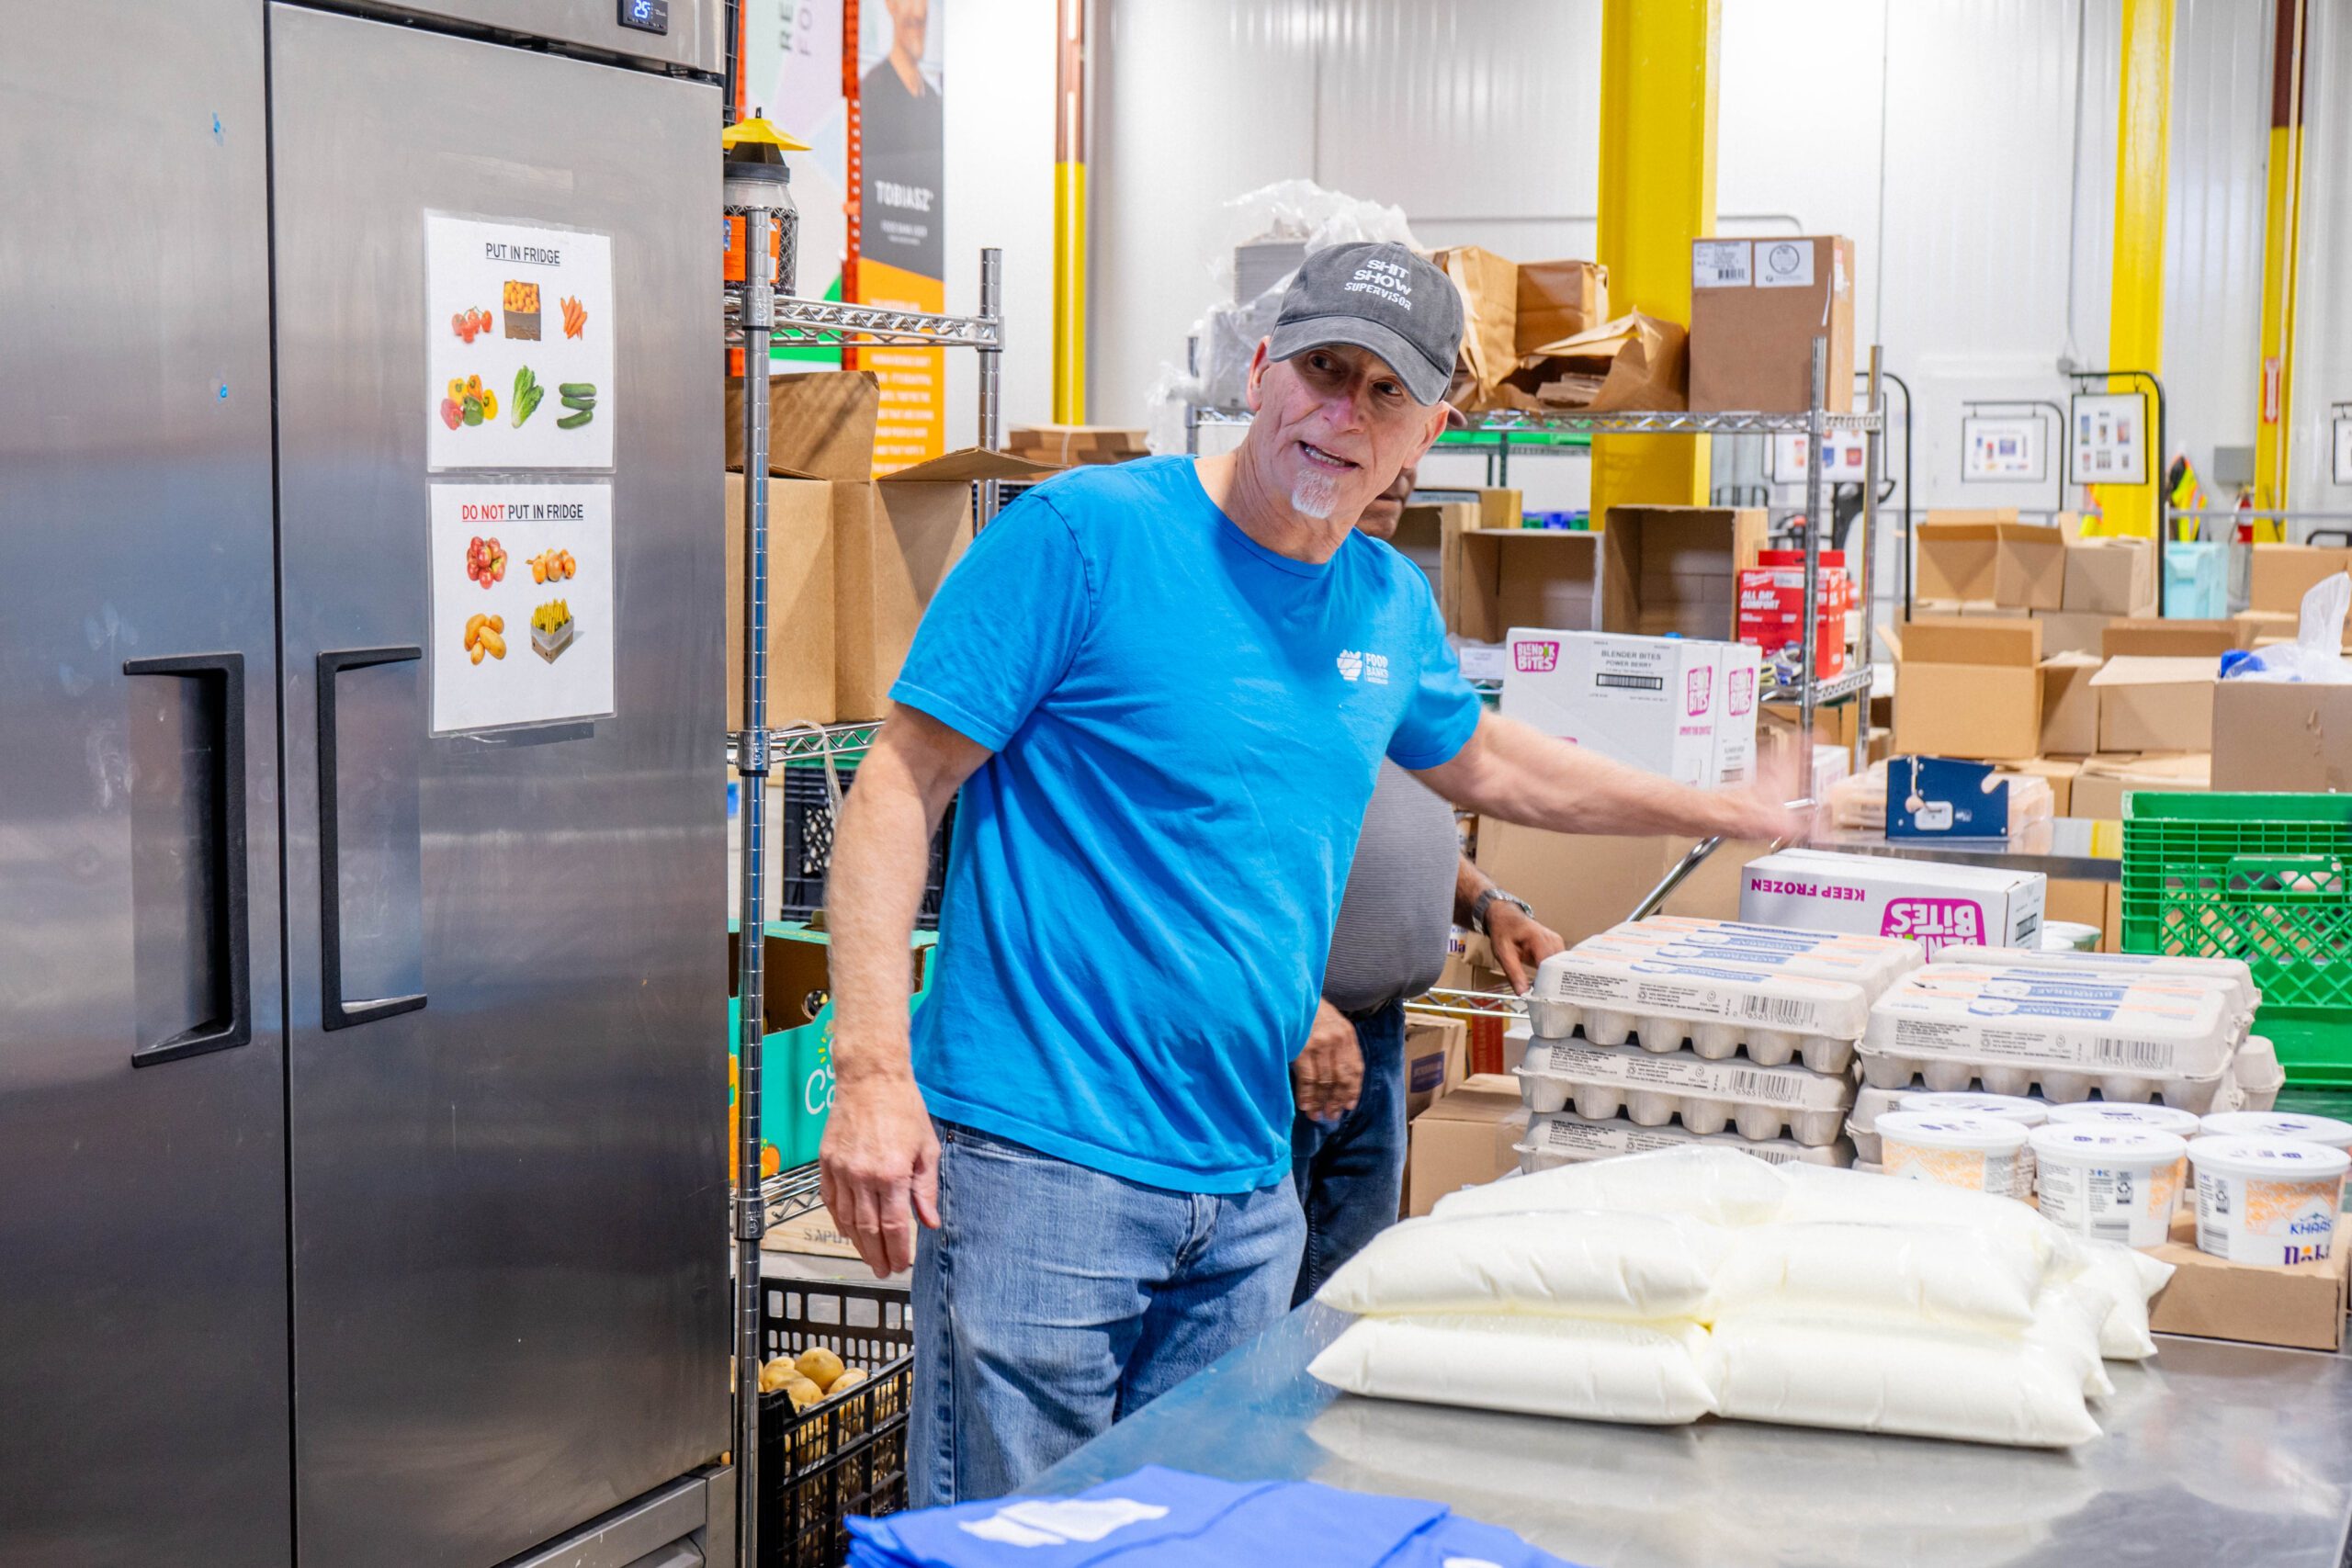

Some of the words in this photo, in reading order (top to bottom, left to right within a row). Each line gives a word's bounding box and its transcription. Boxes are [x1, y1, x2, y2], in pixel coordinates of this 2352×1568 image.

[485, 243, 507, 258] PUT
[510, 245, 521, 260] IN
[524, 246, 560, 265] FRIDGE
[1366, 259, 1409, 279] SHIT
[1352, 269, 1412, 296] SHOW
[462, 504, 478, 520] DO
[481, 504, 505, 520] NOT
[508, 504, 529, 520] PUT
[533, 504, 544, 519] IN
[547, 504, 583, 519] FRIDGE
[1741, 590, 1757, 600] ALL
[1758, 590, 1775, 600] DAY
[1365, 652, 1388, 670] FOOD
[1601, 649, 1637, 659] BLENDER
[1639, 652, 1661, 660] BITES
[1750, 878, 1817, 897] FROZEN
[1822, 886, 1866, 902] KEEP
